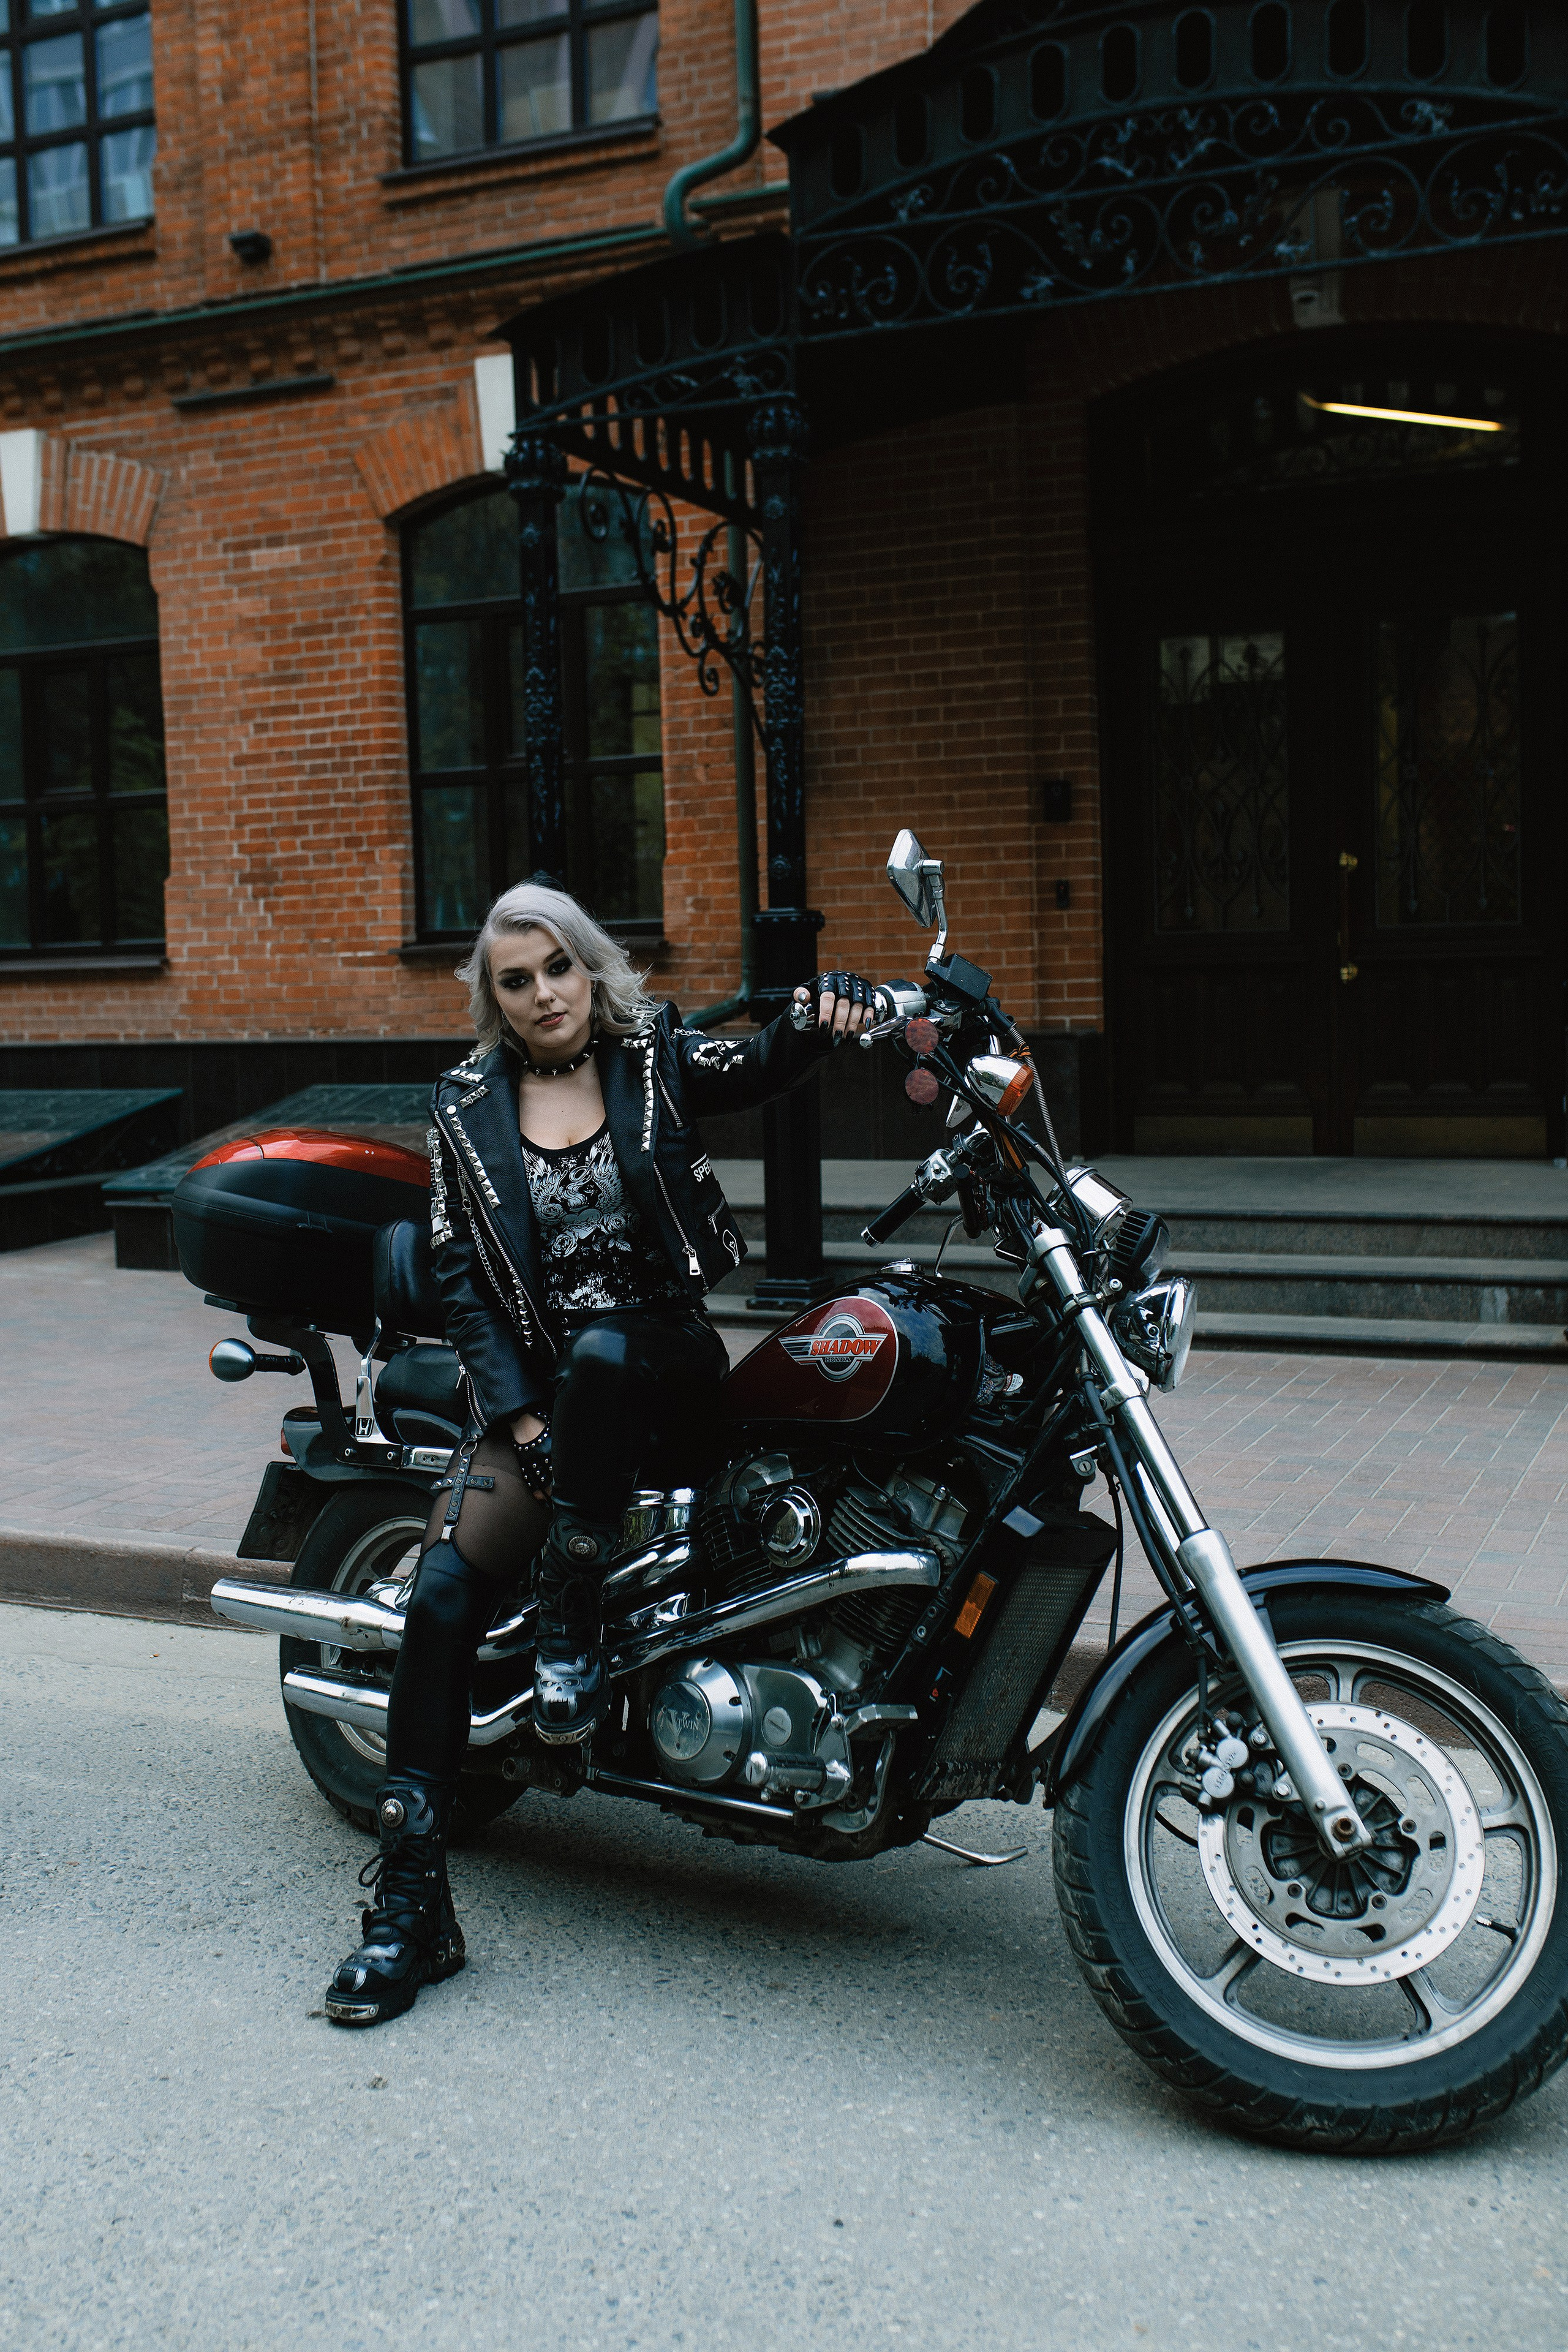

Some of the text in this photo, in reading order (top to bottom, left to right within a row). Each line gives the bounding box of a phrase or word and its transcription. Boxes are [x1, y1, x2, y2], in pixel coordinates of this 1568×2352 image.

[693, 1158, 711, 1182] SPEC
[810, 1339, 881, 1355] SHADOW
[677, 1717, 699, 1731] TWIN
